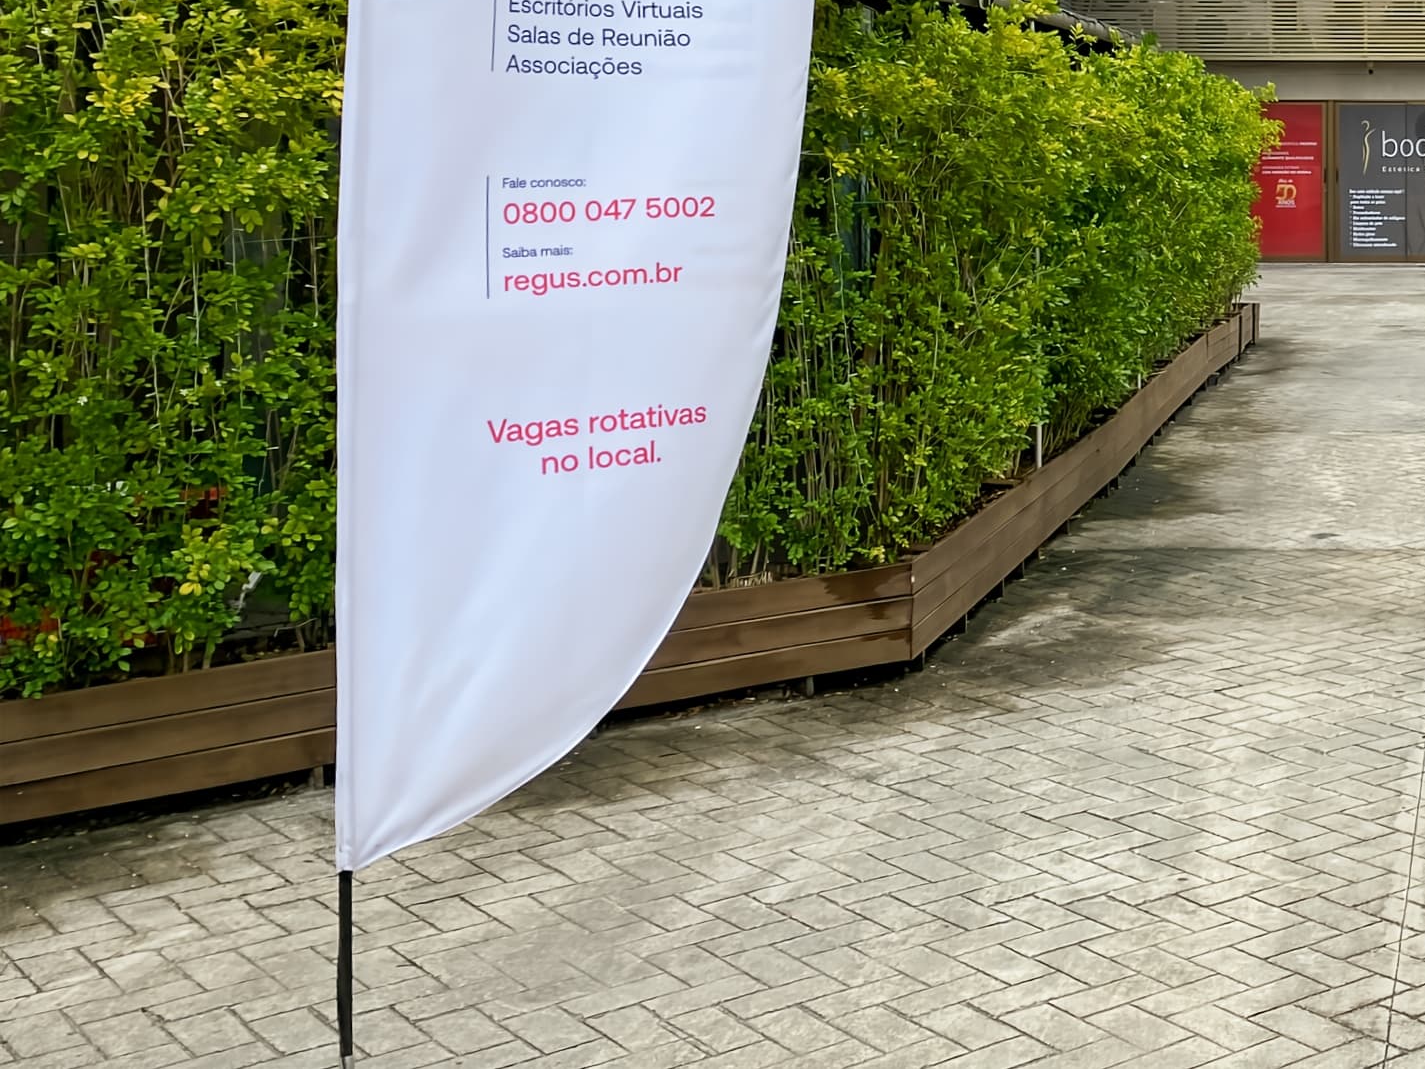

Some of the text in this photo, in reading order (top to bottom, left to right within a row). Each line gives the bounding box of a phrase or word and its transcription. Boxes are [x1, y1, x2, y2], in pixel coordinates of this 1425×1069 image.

[621, 0, 703, 19] Virtuais
[508, 24, 691, 47] Salas de Reunião
[506, 54, 642, 79] Associações
[503, 178, 585, 188] Fale conosco:
[504, 196, 715, 224] 0800 047 5002
[503, 245, 573, 258] Saiba mais:
[505, 262, 683, 296] regus.com.br
[487, 404, 706, 446] Vagas rotativas
[542, 440, 661, 475] no local.
